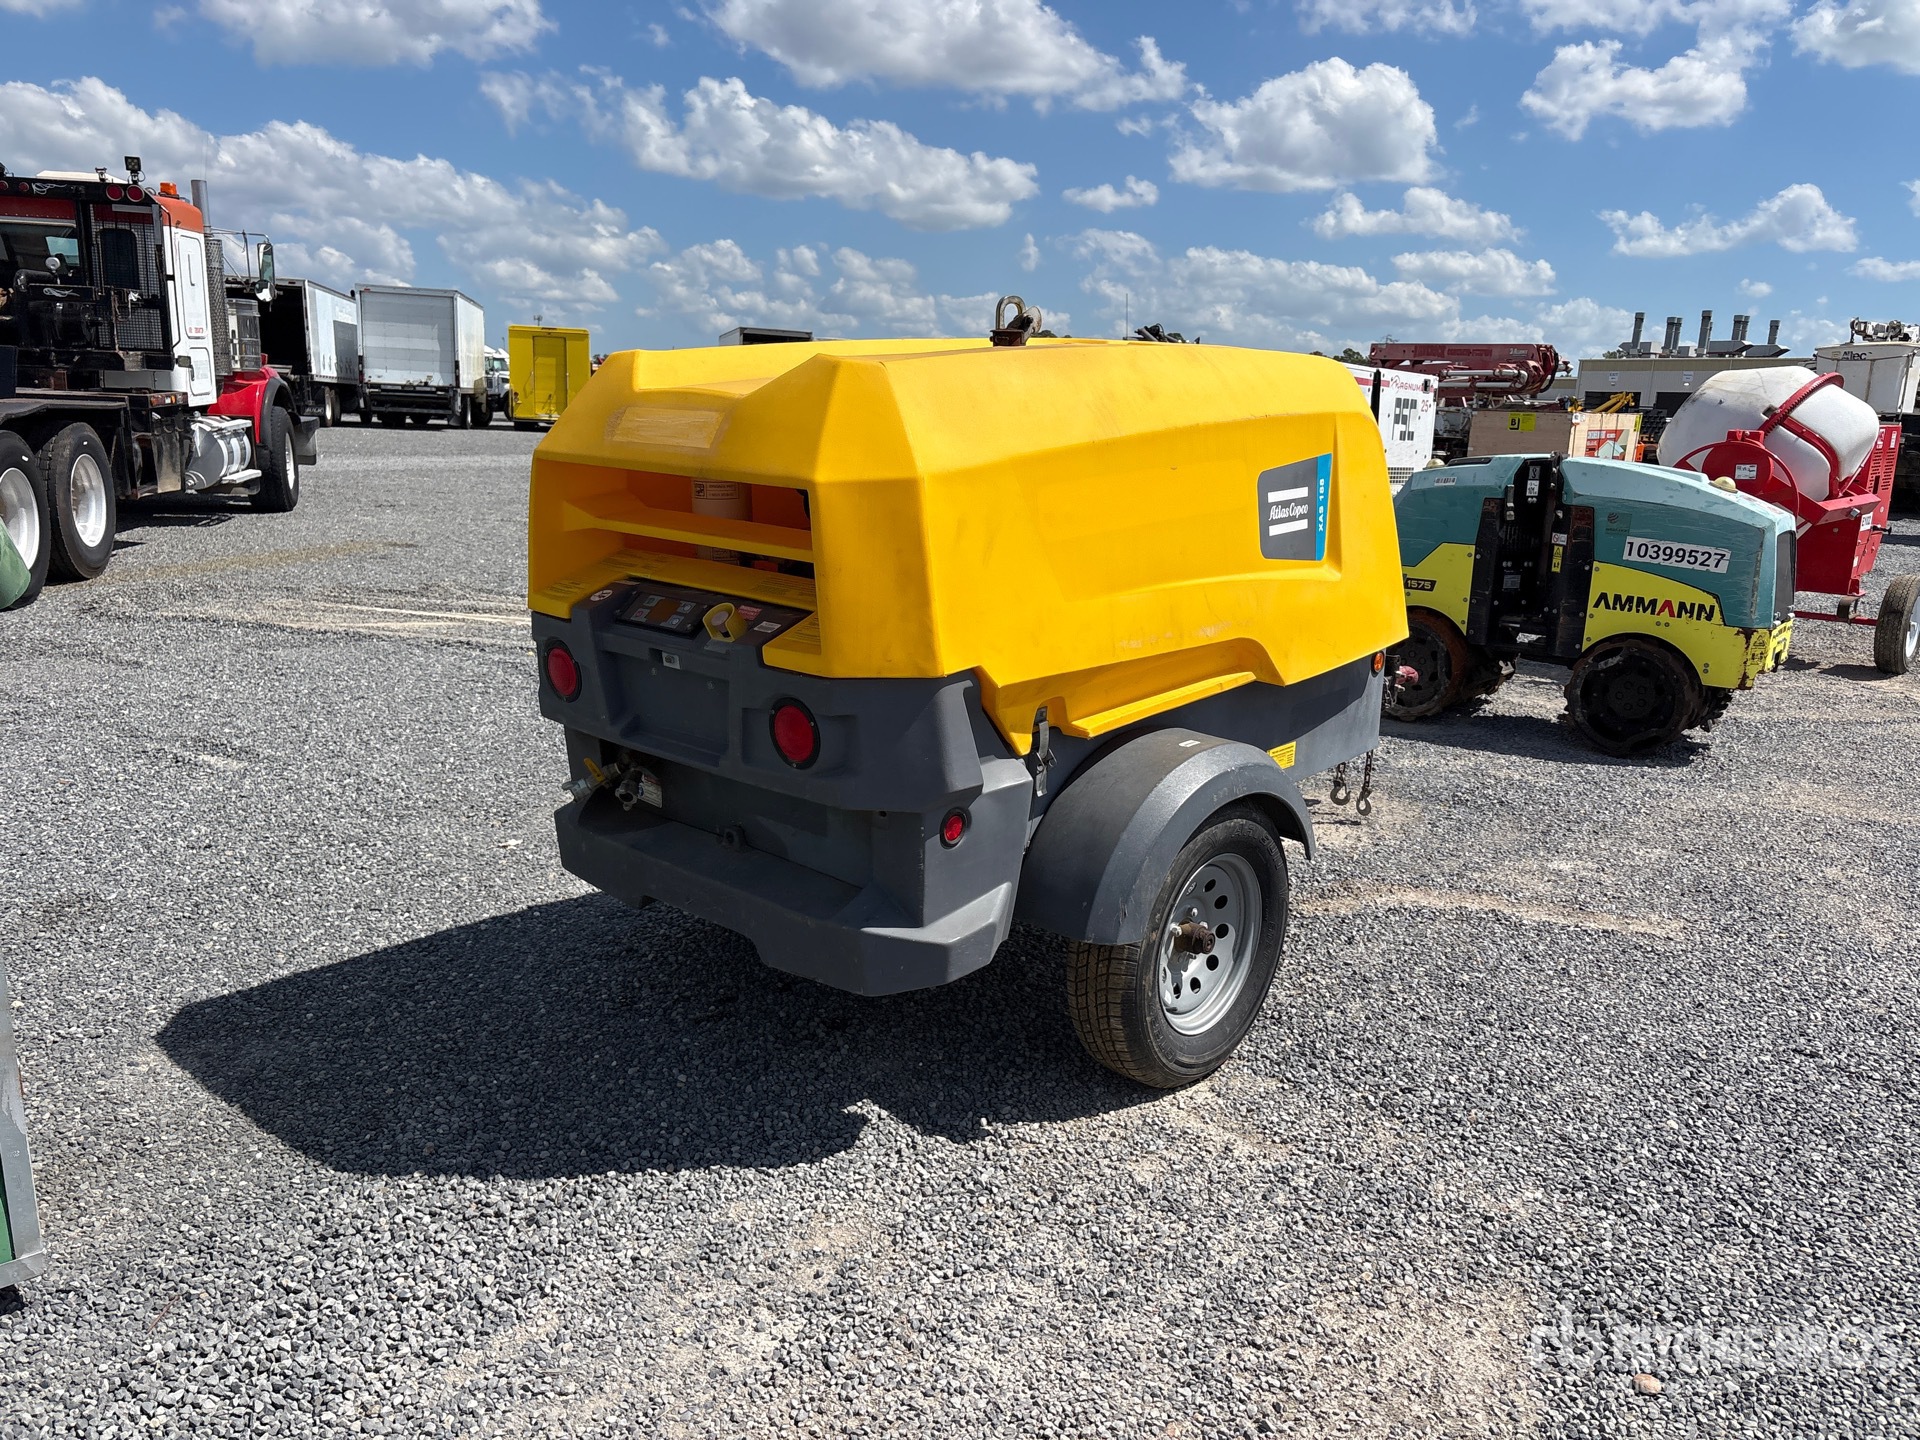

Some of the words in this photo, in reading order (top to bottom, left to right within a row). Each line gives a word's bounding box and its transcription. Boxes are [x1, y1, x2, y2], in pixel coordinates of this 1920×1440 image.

[1268, 504, 1290, 521] Atlas
[1289, 502, 1309, 519] Copco
[1627, 541, 1726, 569] 10399527
[1407, 580, 1432, 589] 1575
[1592, 592, 1715, 622] AMMANN
